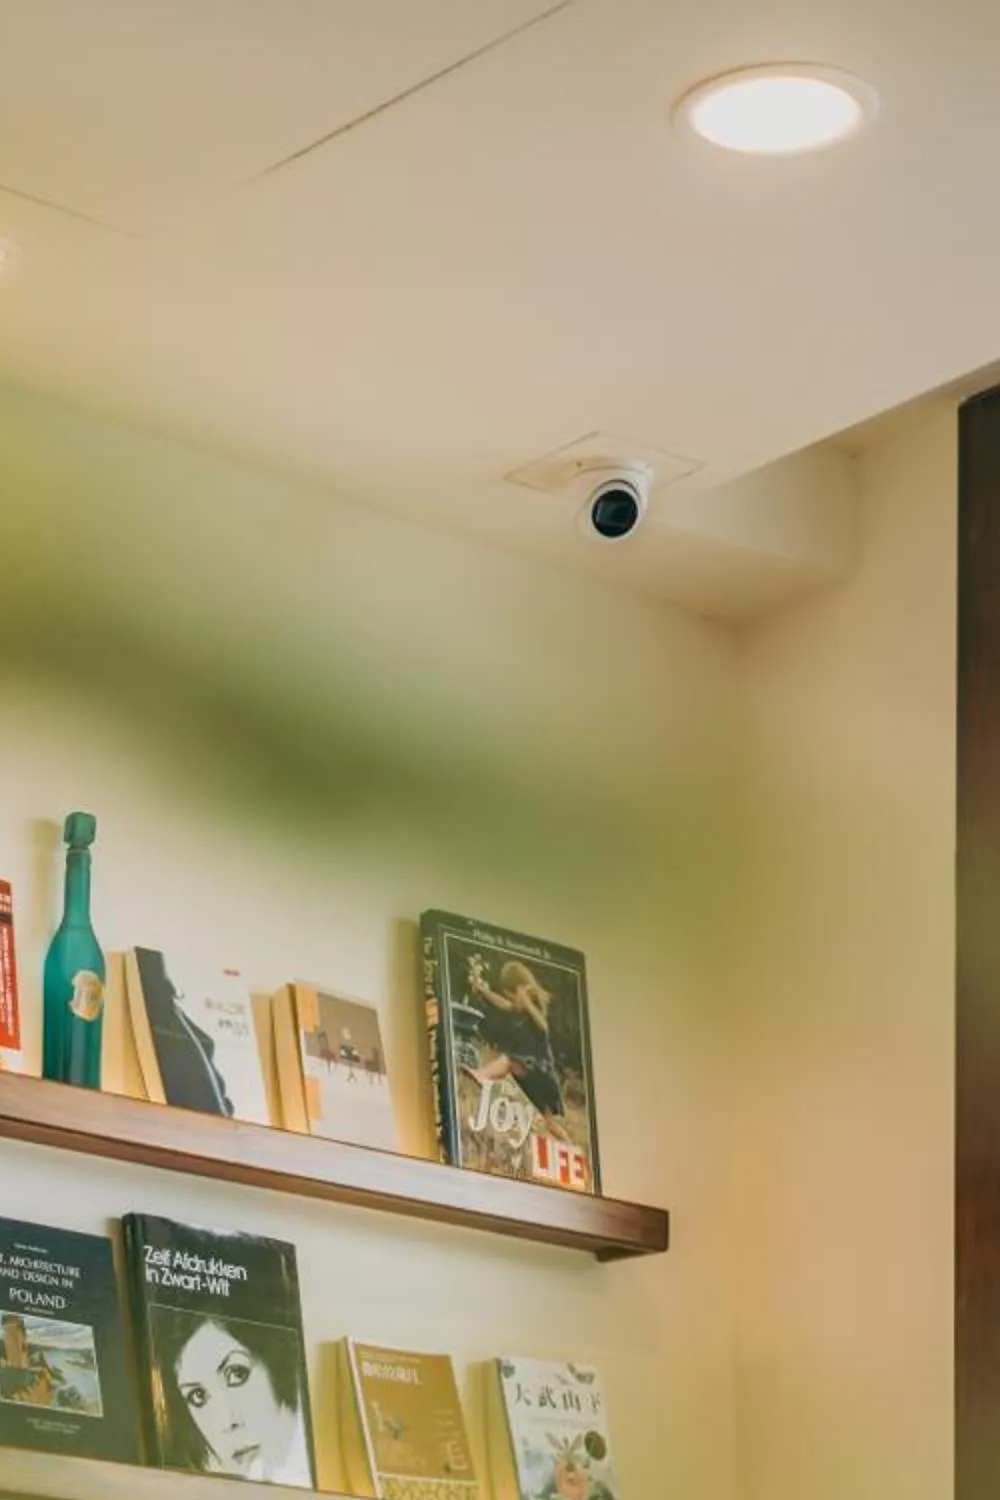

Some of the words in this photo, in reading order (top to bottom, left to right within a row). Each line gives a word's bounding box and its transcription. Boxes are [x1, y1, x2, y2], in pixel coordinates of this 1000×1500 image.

[469, 1080, 533, 1148] Joy
[531, 1135, 587, 1188] LIFE
[9, 1287, 67, 1309] POLAND
